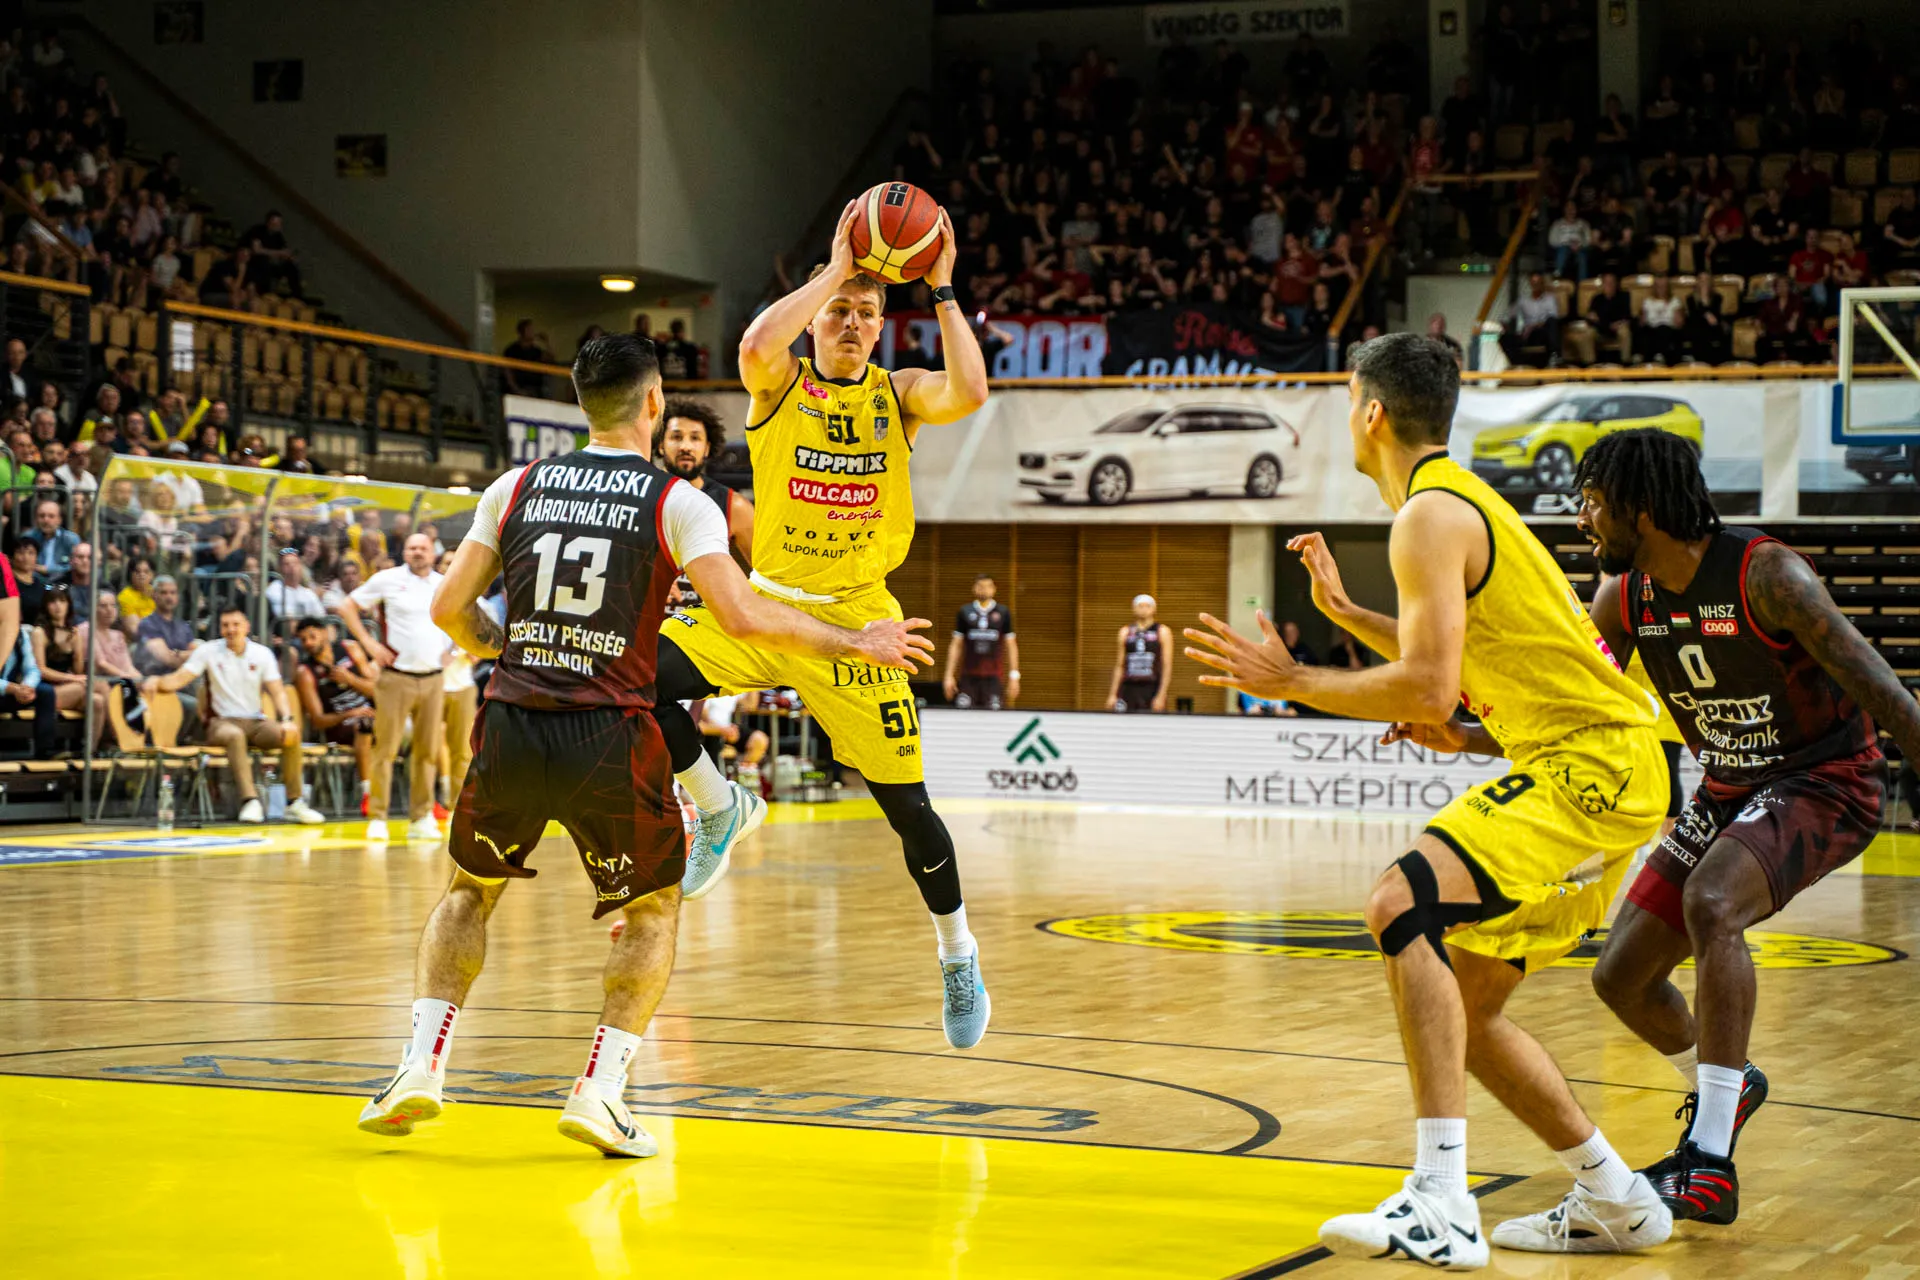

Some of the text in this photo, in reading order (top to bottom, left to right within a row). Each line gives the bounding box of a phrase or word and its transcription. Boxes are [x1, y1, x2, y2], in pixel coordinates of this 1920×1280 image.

[1250, 8, 1343, 33] SZEKTOR
[828, 414, 860, 445] 51
[533, 465, 653, 498] KRNJAJSKI
[792, 481, 875, 504] VULCANO
[606, 503, 639, 532] KFT.
[827, 507, 884, 526] energia
[782, 542, 819, 557] ALPOK
[533, 533, 612, 617] 13
[1699, 604, 1735, 618] NHSZ
[561, 625, 626, 657] PÉKSÉG
[1678, 645, 1716, 688] 0
[879, 699, 918, 739] 51
[1225, 771, 1452, 810] MÉLYÉPÍTŐ
[1482, 773, 1536, 806] 9
